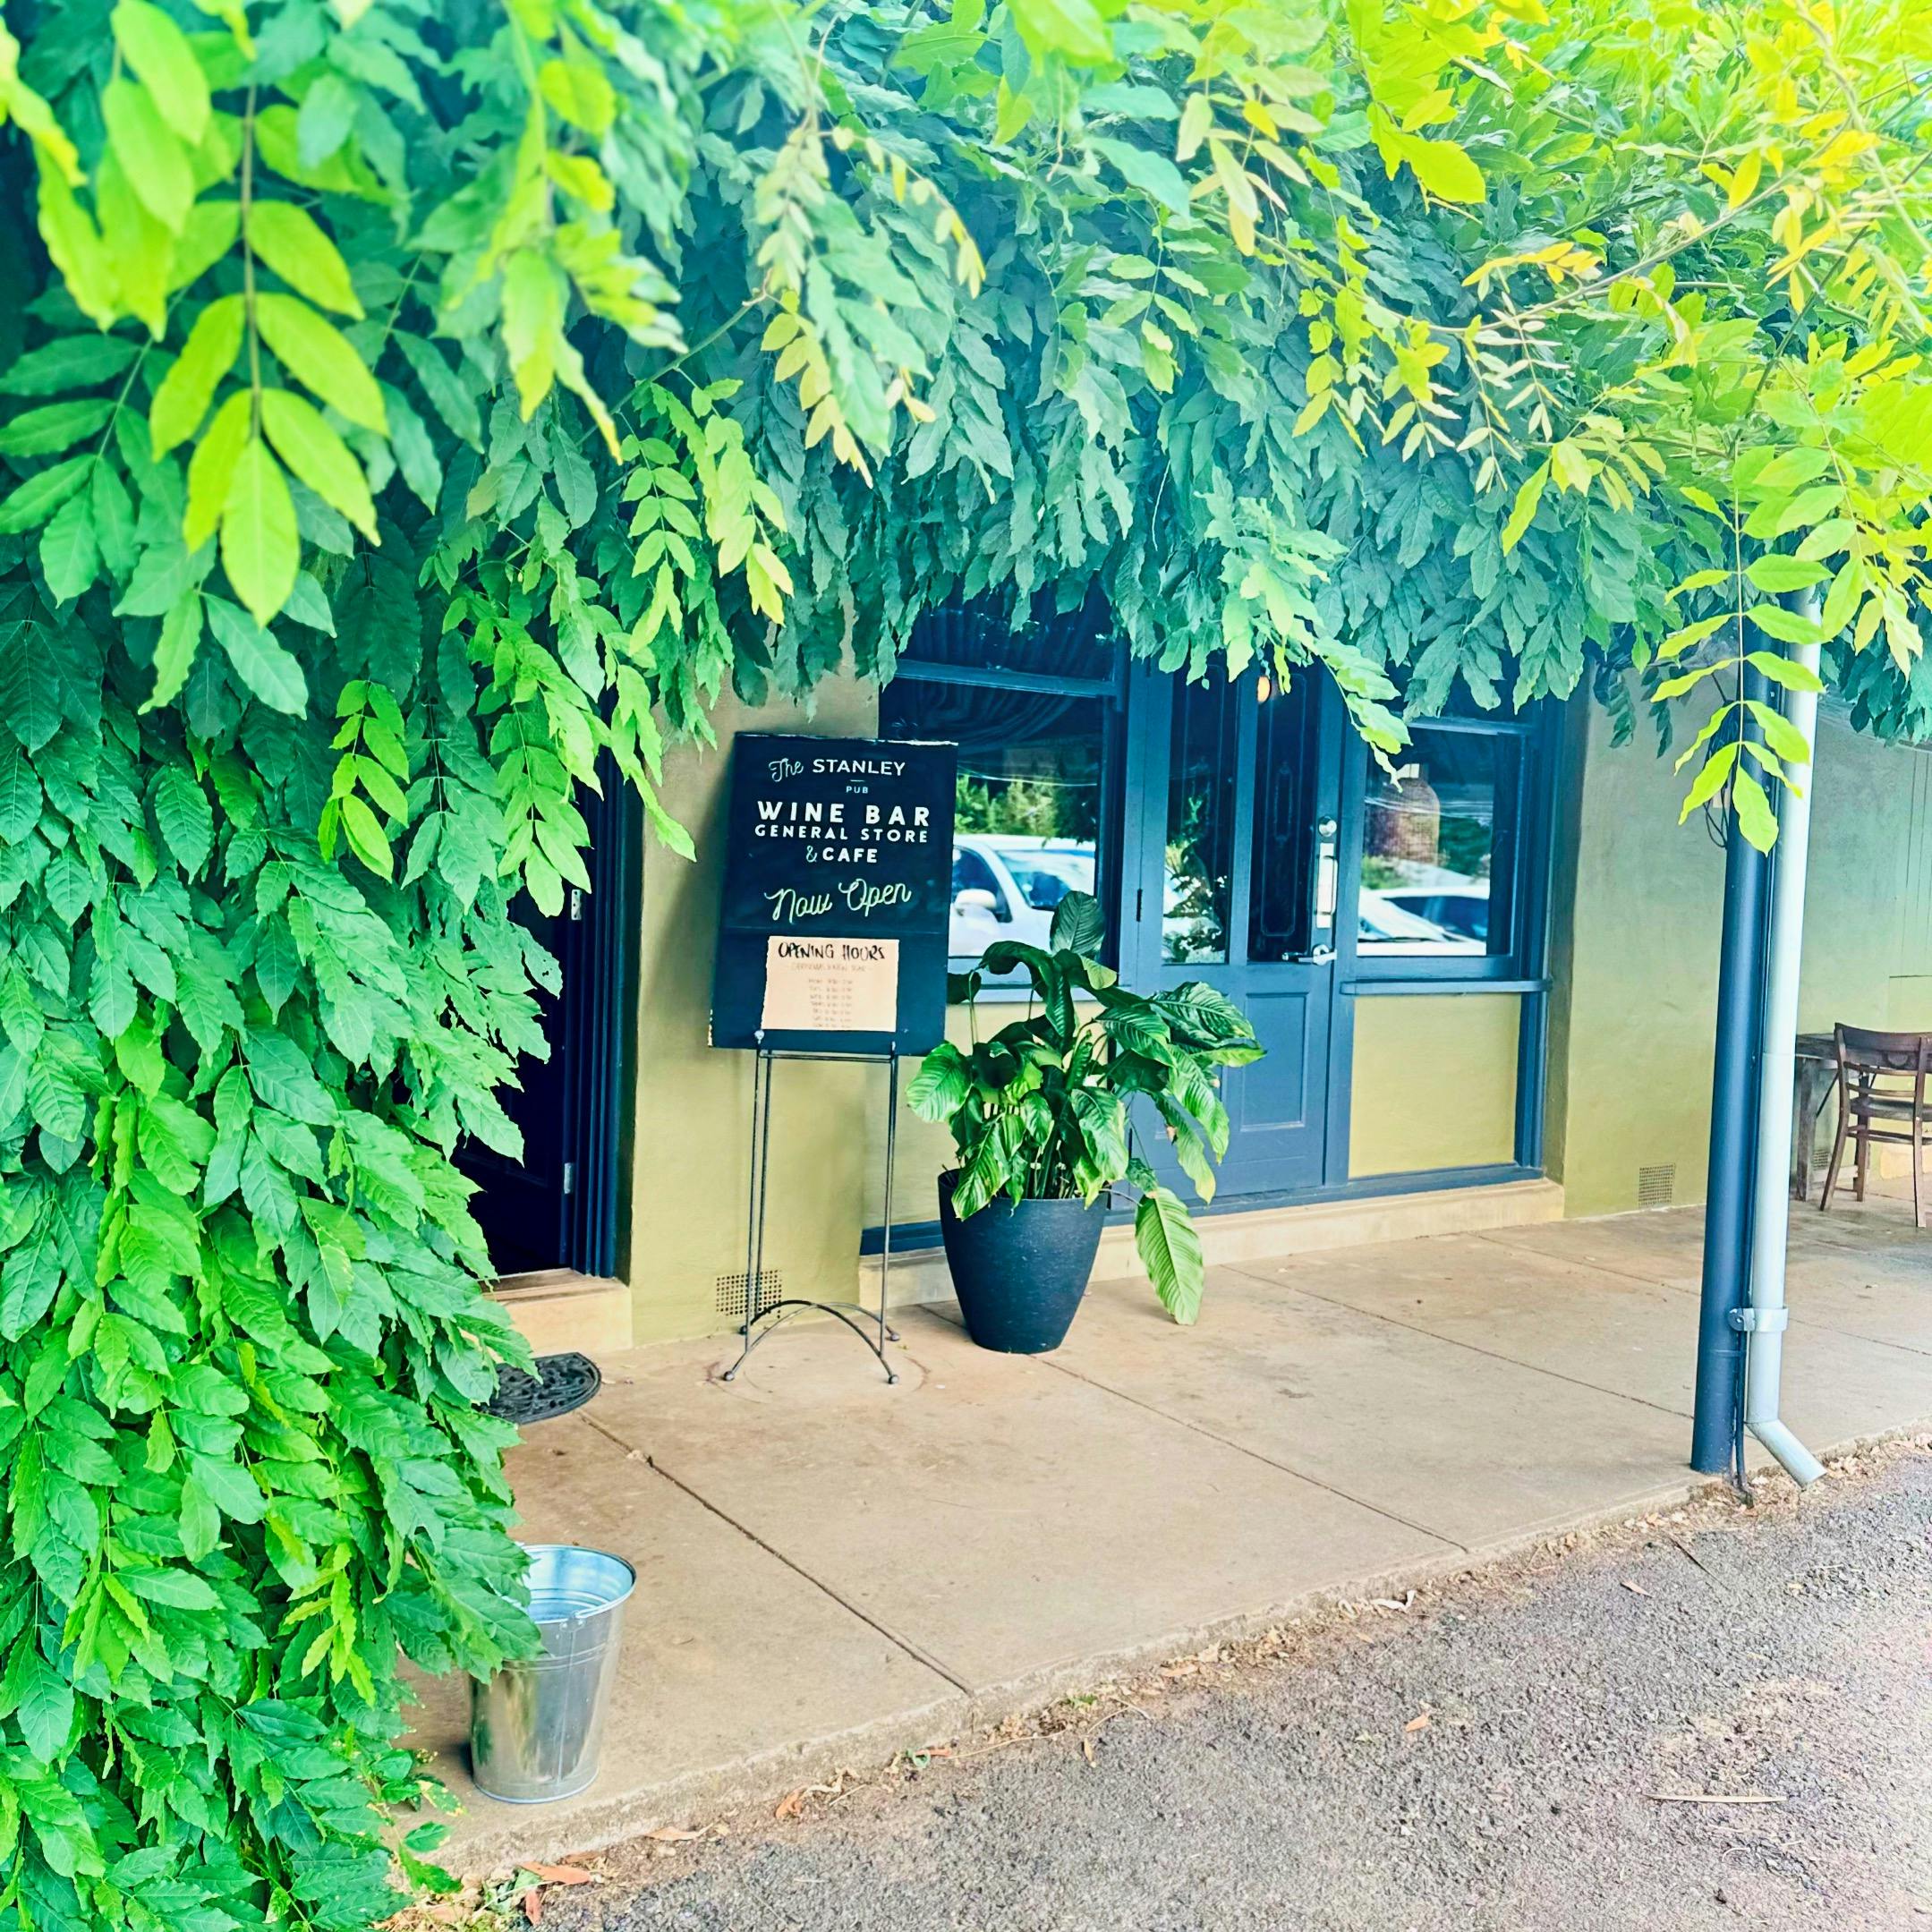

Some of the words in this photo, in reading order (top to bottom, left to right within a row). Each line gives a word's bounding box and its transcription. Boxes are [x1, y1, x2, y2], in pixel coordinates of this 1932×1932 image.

[769, 758, 804, 782] The
[813, 759, 905, 776] STANLEY
[758, 801, 844, 822] WINE
[866, 805, 929, 826] BAR
[755, 824, 847, 839] GENERAL
[861, 829, 927, 842] STORE
[806, 846, 817, 863] &
[822, 847, 877, 863] CAFE
[764, 889, 832, 923] Now
[838, 879, 912, 916] Open
[779, 942, 833, 958] OPENING
[843, 945, 884, 960] HOURS
